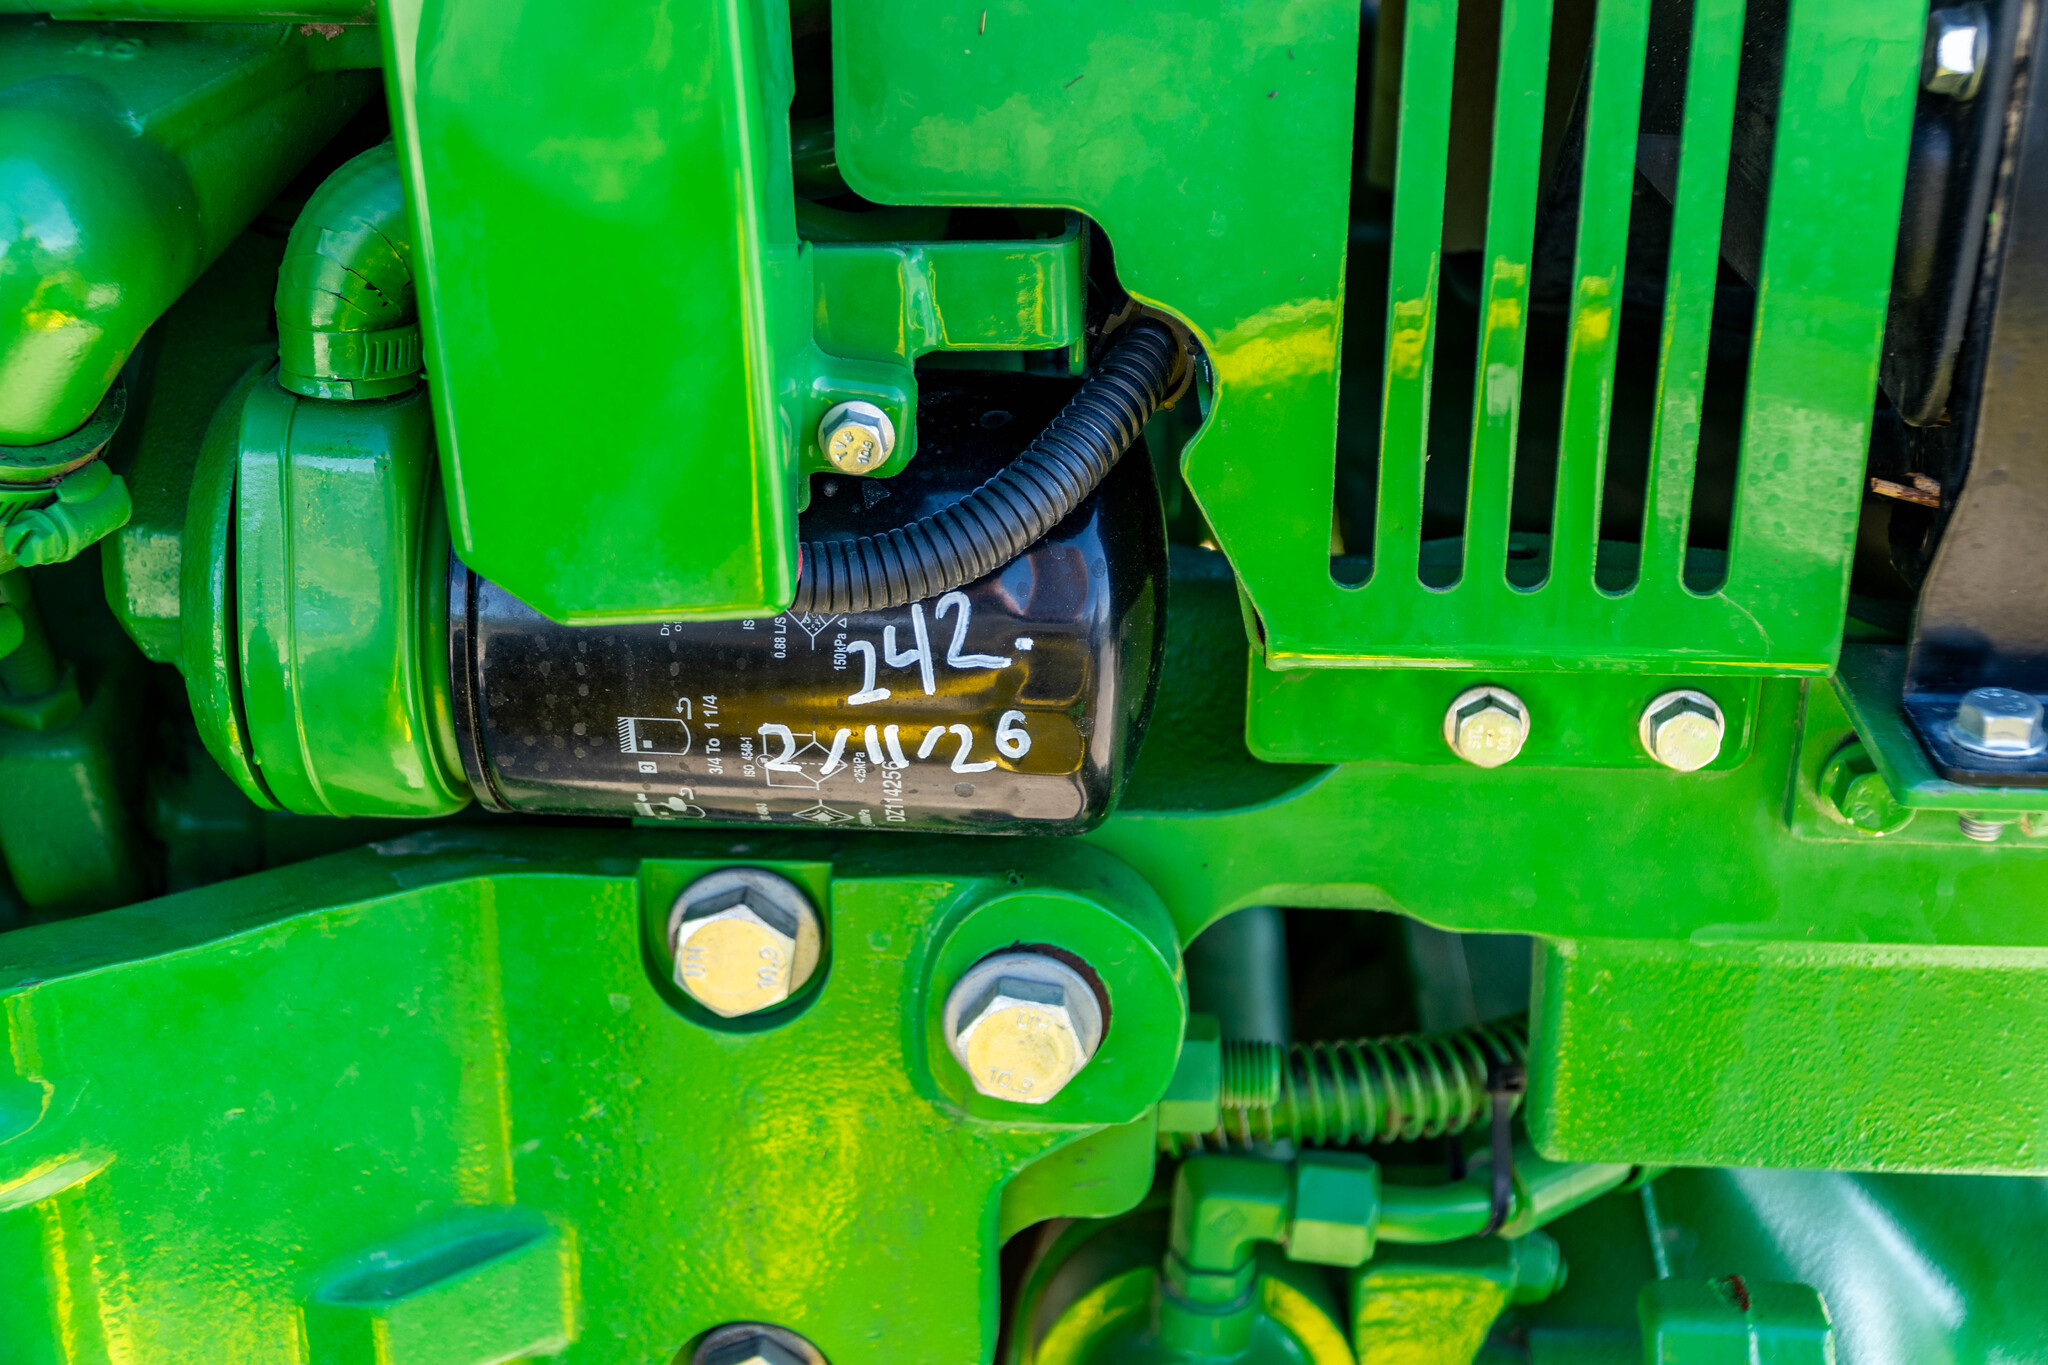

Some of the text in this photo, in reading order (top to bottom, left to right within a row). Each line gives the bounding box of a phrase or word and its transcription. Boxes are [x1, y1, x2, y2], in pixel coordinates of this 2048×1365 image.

[774, 616, 787, 659] 0.88 L/S
[833, 632, 848, 671] 150kPa
[702, 694, 719, 717] 1/4
[705, 738, 721, 754] To
[708, 757, 724, 775] 3/4
[743, 764, 756, 777] ISO
[757, 946, 779, 988] 10.9
[987, 1066, 1036, 1095] 10.9
